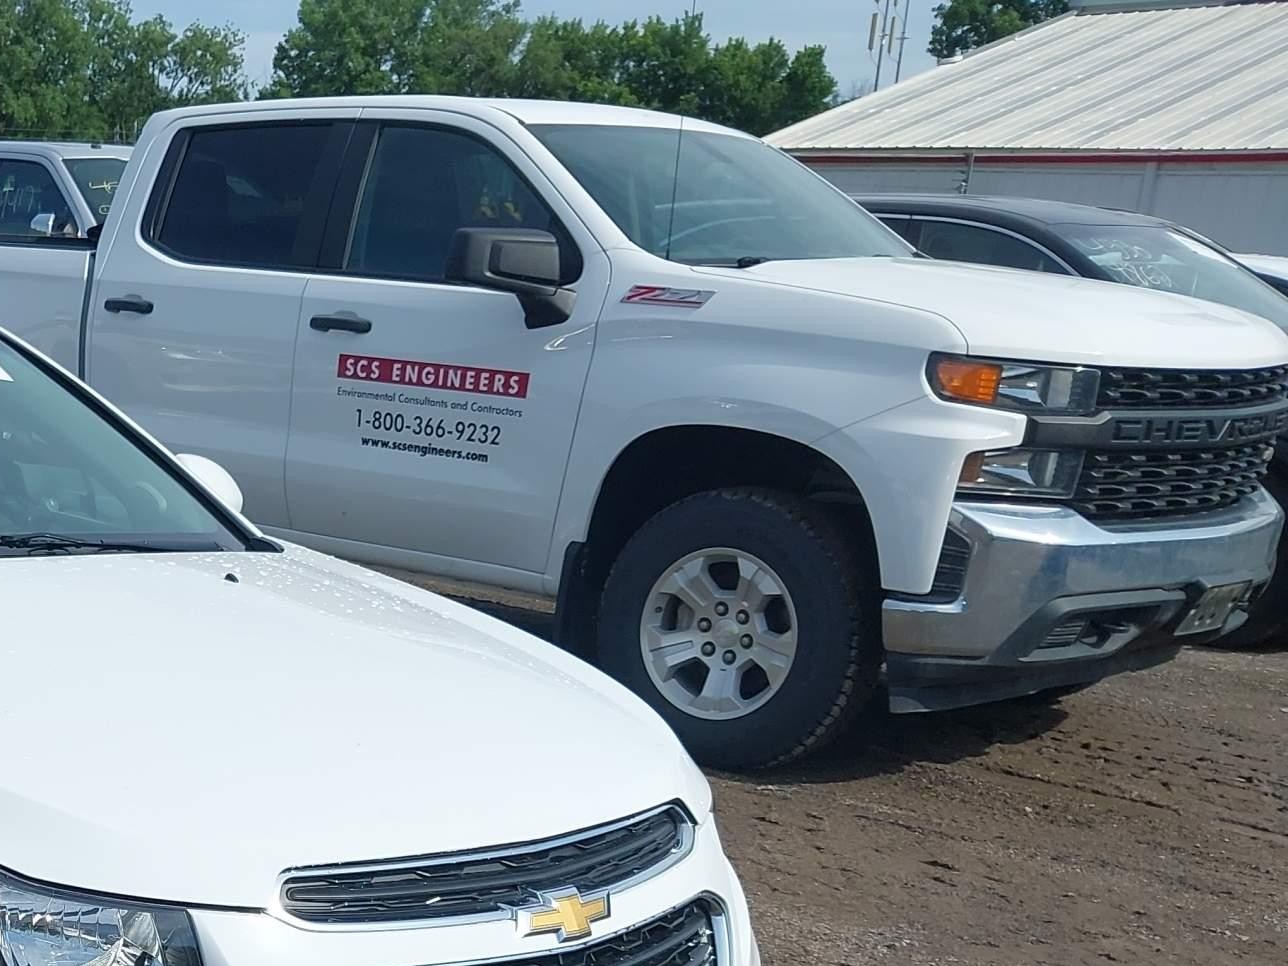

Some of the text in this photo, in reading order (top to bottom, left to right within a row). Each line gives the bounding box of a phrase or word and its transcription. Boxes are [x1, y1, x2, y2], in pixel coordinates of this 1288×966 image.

[345, 359, 520, 395] SCS ENGINEERS
[337, 387, 523, 418] Environmental Consultants and Contractors
[355, 408, 502, 445] 1-800-366-9232
[361, 436, 489, 463] www.scsengineers.com
